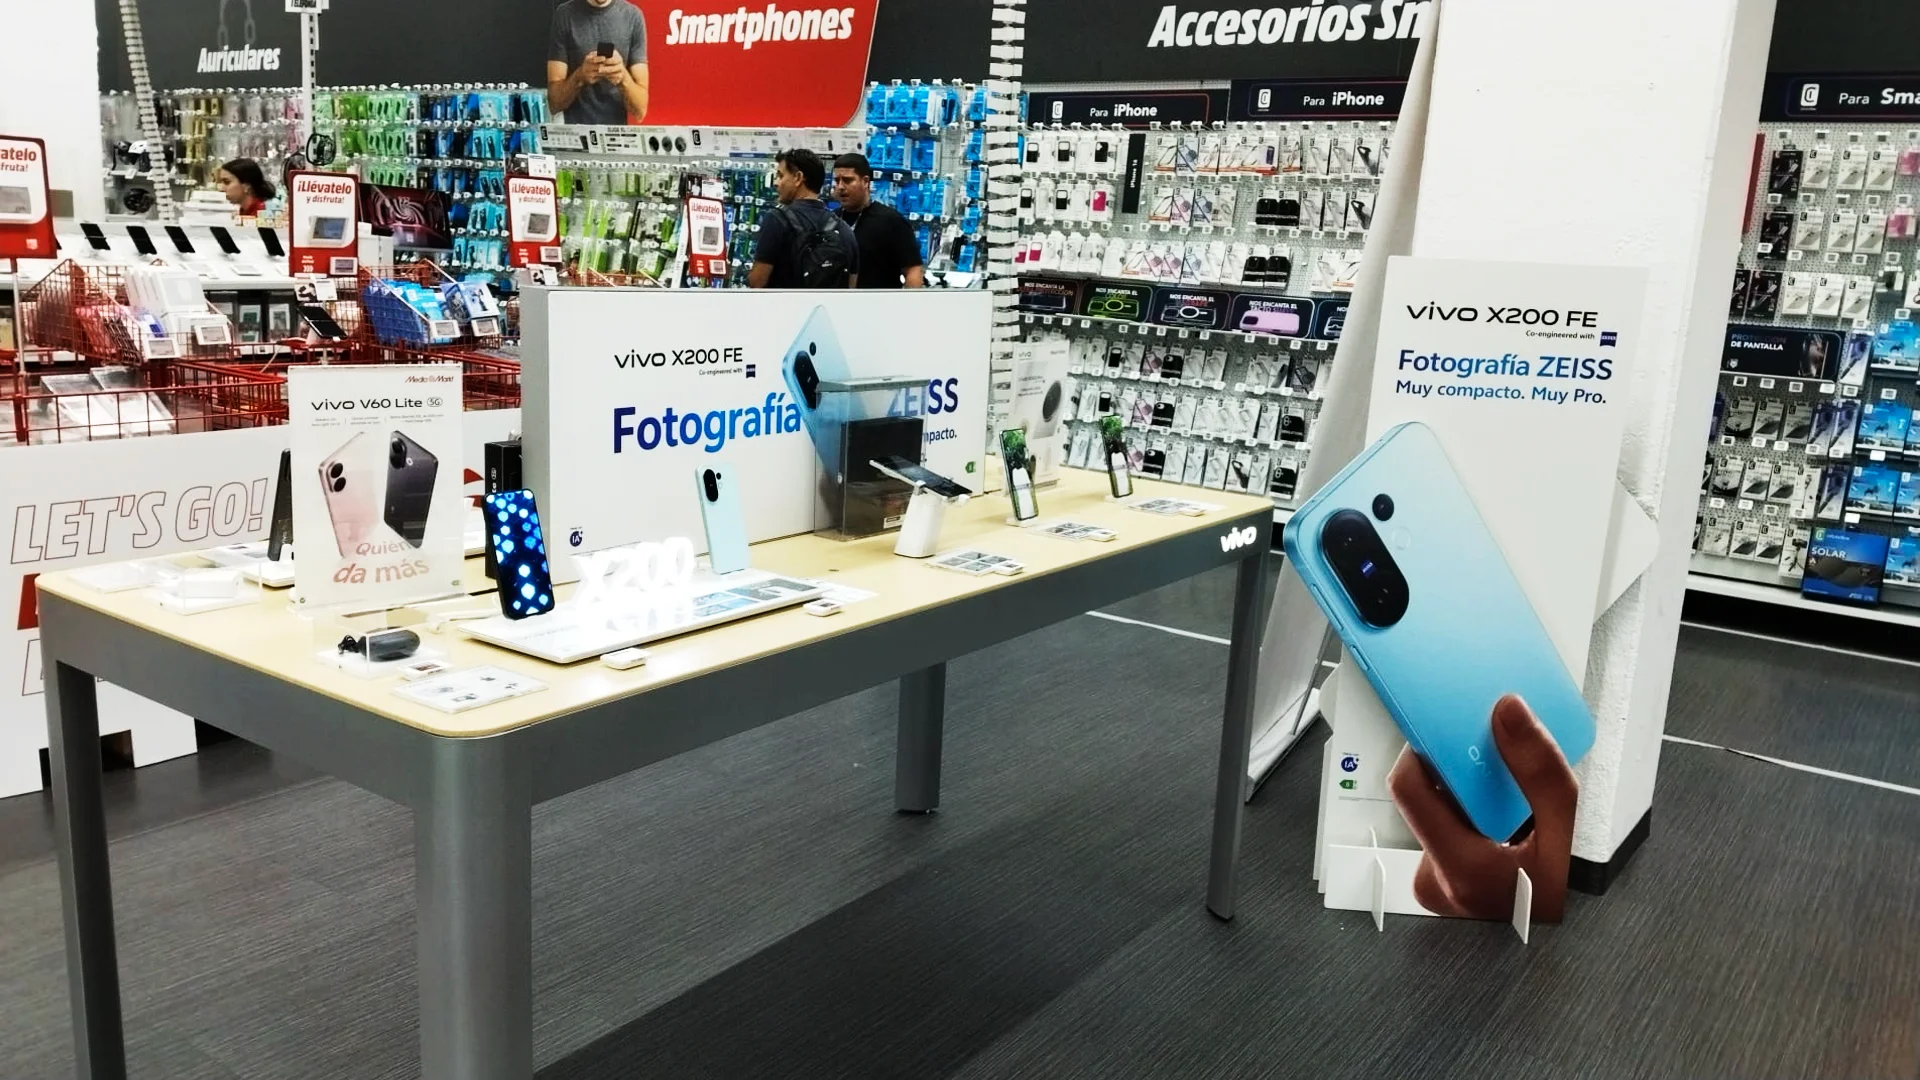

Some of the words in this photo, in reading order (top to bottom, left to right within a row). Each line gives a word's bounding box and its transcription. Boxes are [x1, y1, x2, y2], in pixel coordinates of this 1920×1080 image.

[666, 3, 855, 50] Smartphones
[1147, 0, 1372, 47] Accesorios
[197, 44, 281, 73] Auriculares
[1090, 107, 1109, 117] Para
[1113, 103, 1158, 117] iPhone
[1303, 95, 1326, 106] Para
[1332, 91, 1384, 106] iPhone
[1839, 92, 1870, 105] Para
[0, 147, 37, 161] atelo
[298, 180, 352, 194] ¡Llévatelo
[1407, 301, 1478, 322] vivo
[1486, 306, 1559, 325] X200
[1566, 310, 1598, 327] FE
[1525, 329, 1578, 340] Co-engineered
[1579, 332, 1595, 340] with
[1730, 340, 1742, 348] DE
[1743, 341, 1783, 351] PANTALLA
[614, 349, 666, 369] vivo
[671, 348, 719, 366] X200
[723, 347, 743, 363] FE
[1398, 348, 1530, 378] Fotografía
[1536, 356, 1613, 380] ZEISS
[311, 398, 355, 411] vivo
[360, 398, 391, 409] V60
[395, 397, 423, 408] Lite
[1395, 380, 1433, 398] Muy
[1437, 385, 1525, 400] compacto.
[1532, 386, 1568, 405] Muy
[1573, 388, 1607, 404] Pro.
[613, 391, 800, 454] Fotografía
[886, 377, 959, 417] ZEISS
[10, 490, 166, 564] LET'S
[175, 477, 268, 542] GO!
[1220, 526, 1257, 553] vivo
[1811, 547, 1847, 559] SOLAR
[333, 563, 367, 584] da
[375, 558, 430, 583] más
